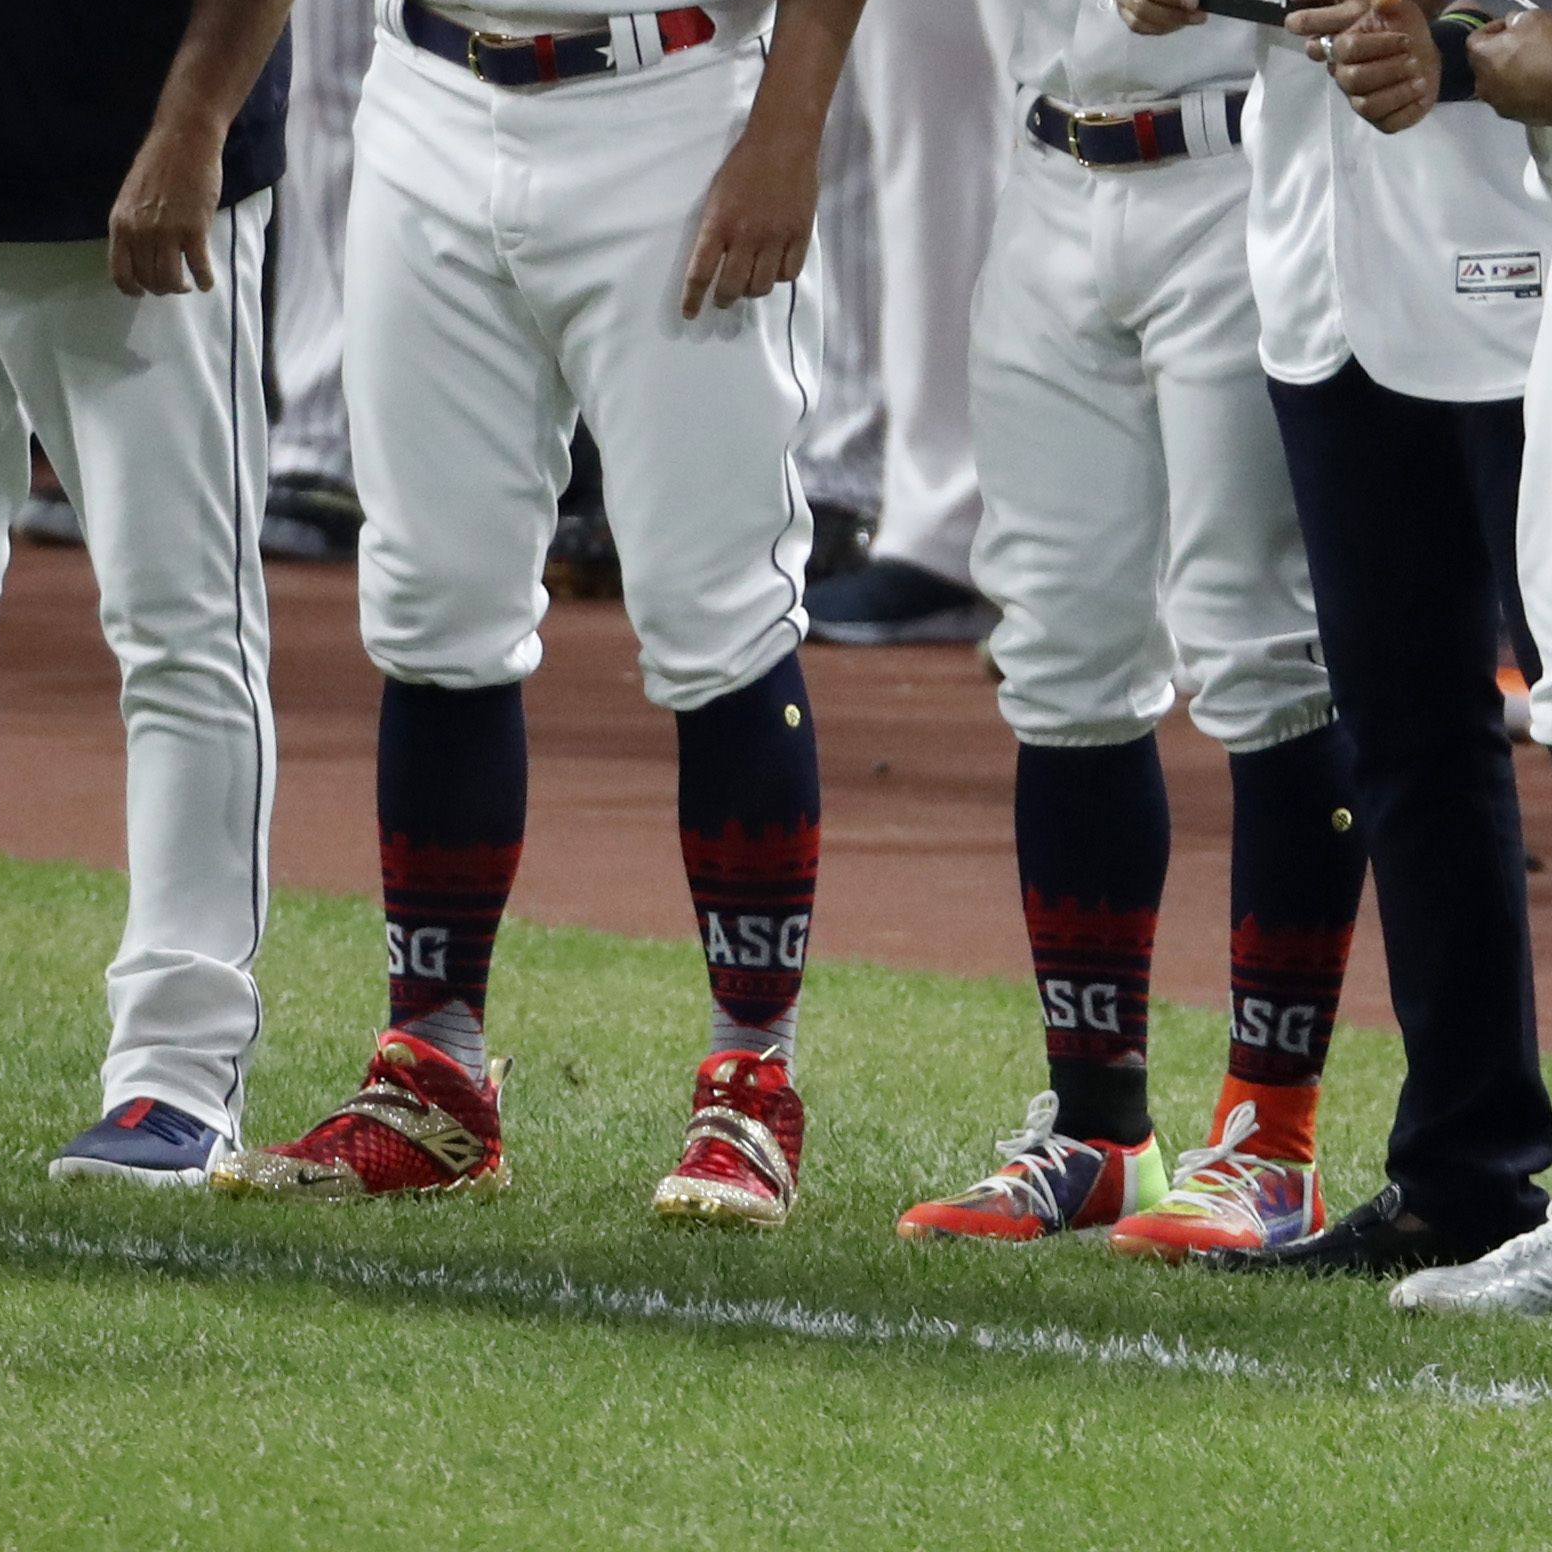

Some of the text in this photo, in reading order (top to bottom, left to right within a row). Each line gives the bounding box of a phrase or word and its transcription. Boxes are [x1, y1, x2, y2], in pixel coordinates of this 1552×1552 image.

[386, 922, 449, 981] SG
[708, 911, 810, 972] ASG
[1045, 979, 1121, 1034] SG
